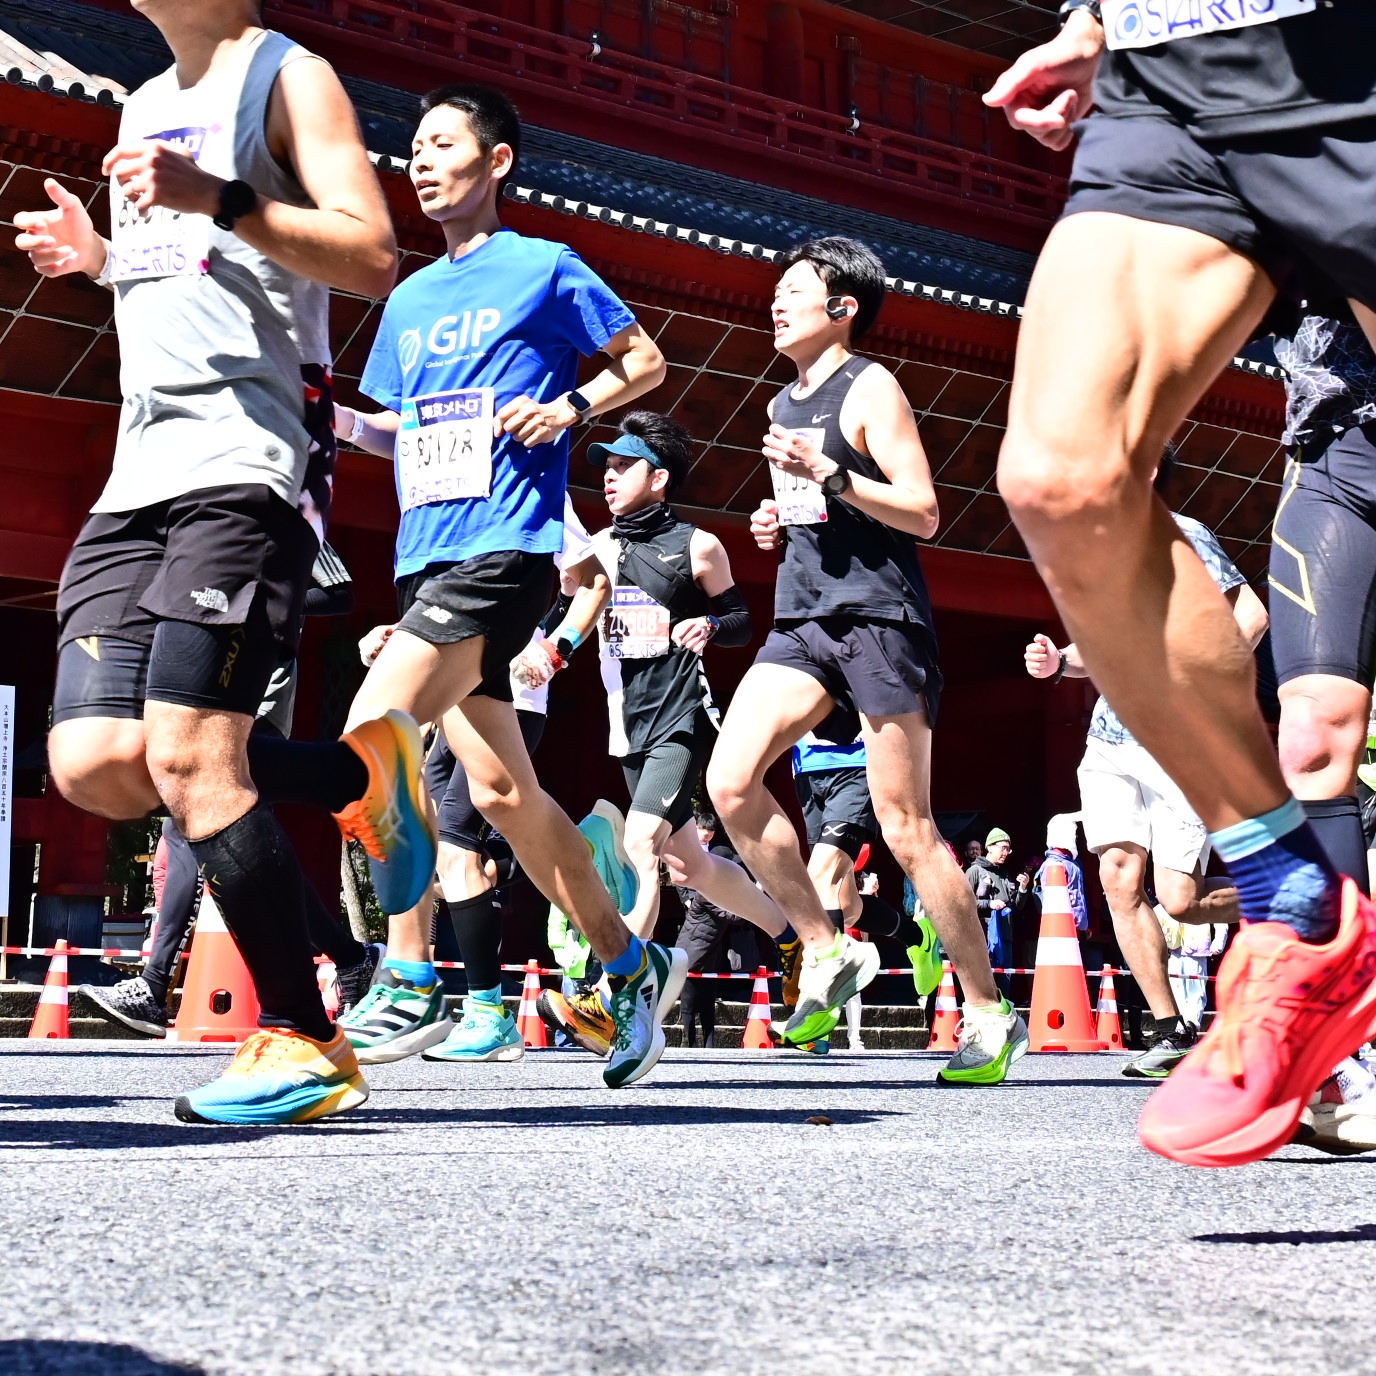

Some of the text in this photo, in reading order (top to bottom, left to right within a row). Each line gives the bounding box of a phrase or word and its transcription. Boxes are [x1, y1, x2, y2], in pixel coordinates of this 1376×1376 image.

[427, 308, 501, 355] GIP
[425, 359, 444, 369] Global
[420, 398, 480, 420] 東京メトロ
[190, 590, 218, 603] NORTH
